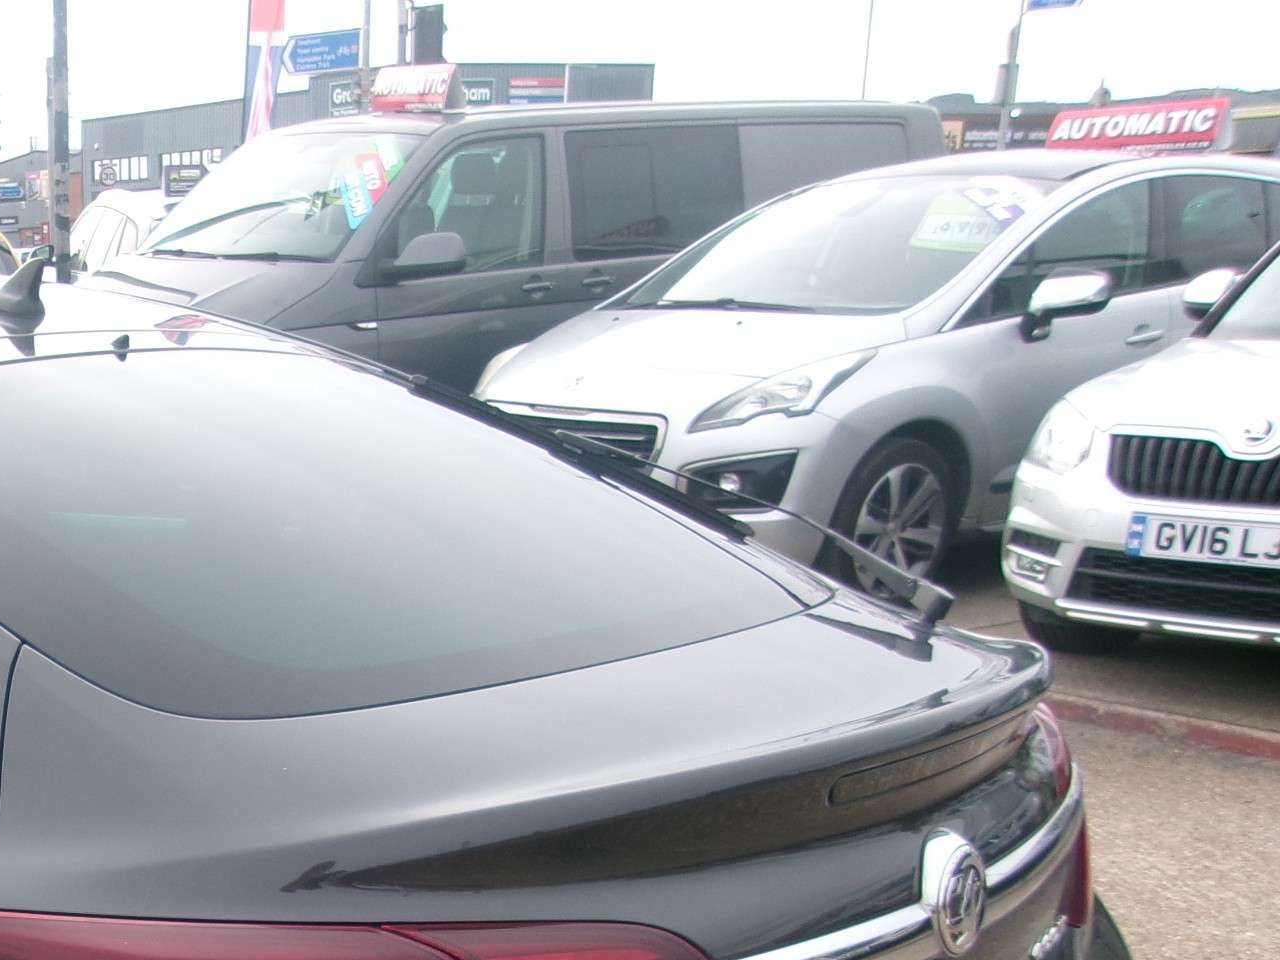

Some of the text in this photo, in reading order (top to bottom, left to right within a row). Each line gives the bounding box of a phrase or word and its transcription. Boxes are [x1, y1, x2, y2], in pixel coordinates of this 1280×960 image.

[373, 72, 449, 97] AUTOMATIC
[1051, 108, 1217, 141] AUTOMATIC
[1155, 522, 1231, 556] GV16
